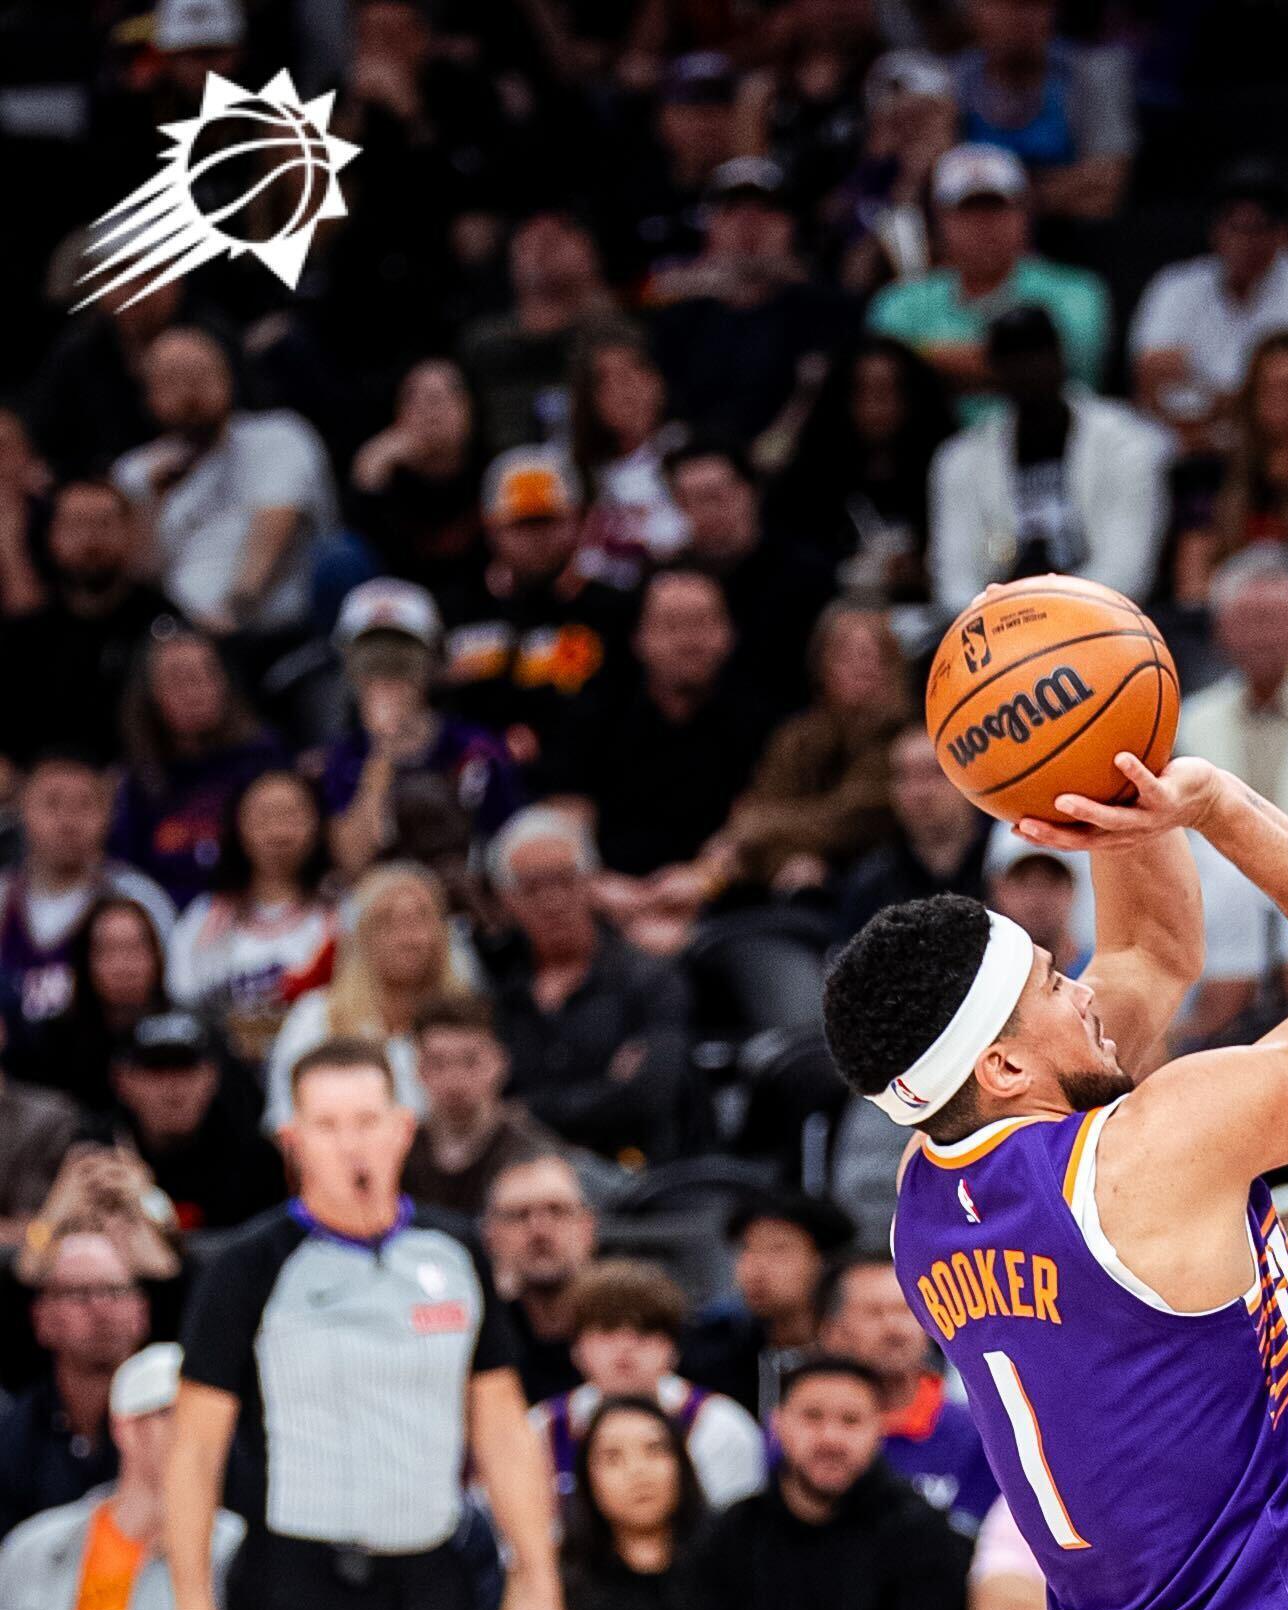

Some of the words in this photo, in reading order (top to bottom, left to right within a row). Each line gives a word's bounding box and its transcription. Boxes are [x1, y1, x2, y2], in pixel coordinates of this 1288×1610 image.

[946, 665, 1096, 768] Wilson
[917, 1248, 1062, 1341] BOOKER
[982, 1350, 1092, 1549] 1
